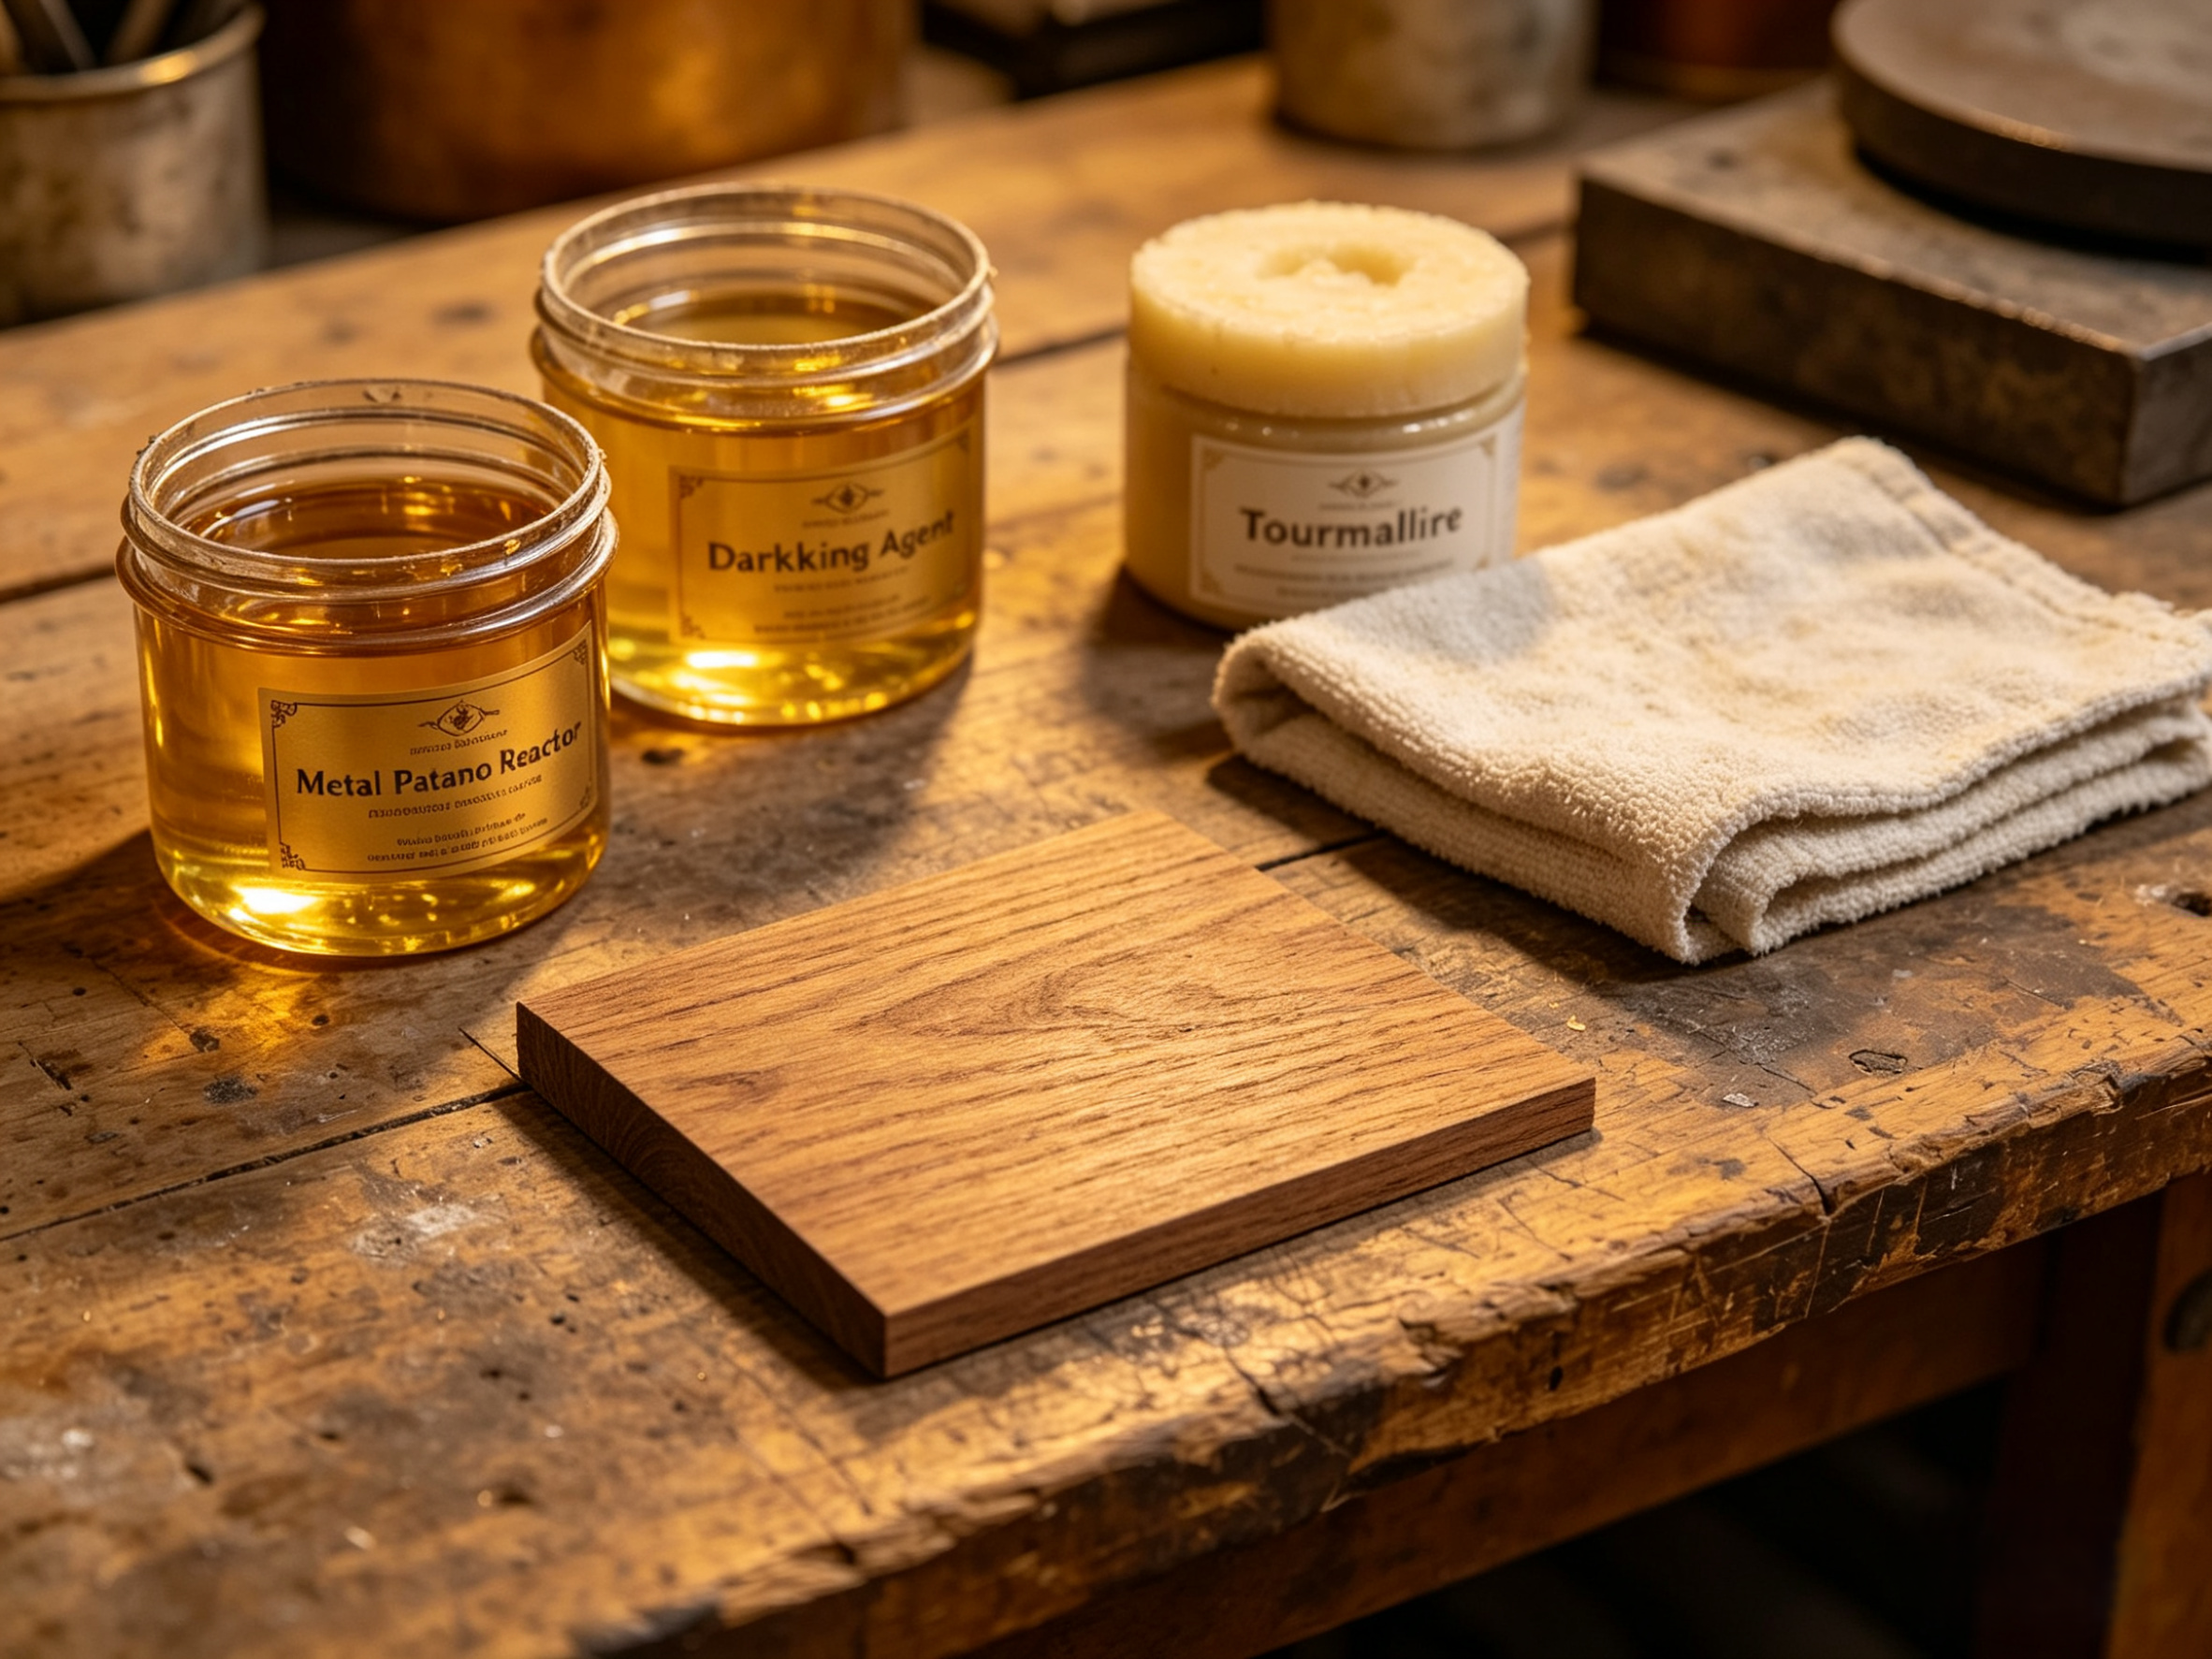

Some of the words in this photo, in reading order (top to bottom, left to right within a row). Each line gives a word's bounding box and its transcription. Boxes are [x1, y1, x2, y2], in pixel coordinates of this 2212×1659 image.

[707, 541, 870, 573] Darkking
[880, 510, 954, 559] Agent
[1239, 506, 1463, 547] Tourmallire
[297, 768, 381, 796] Metal
[394, 762, 492, 794] Patano
[500, 720, 582, 775] Reactor
